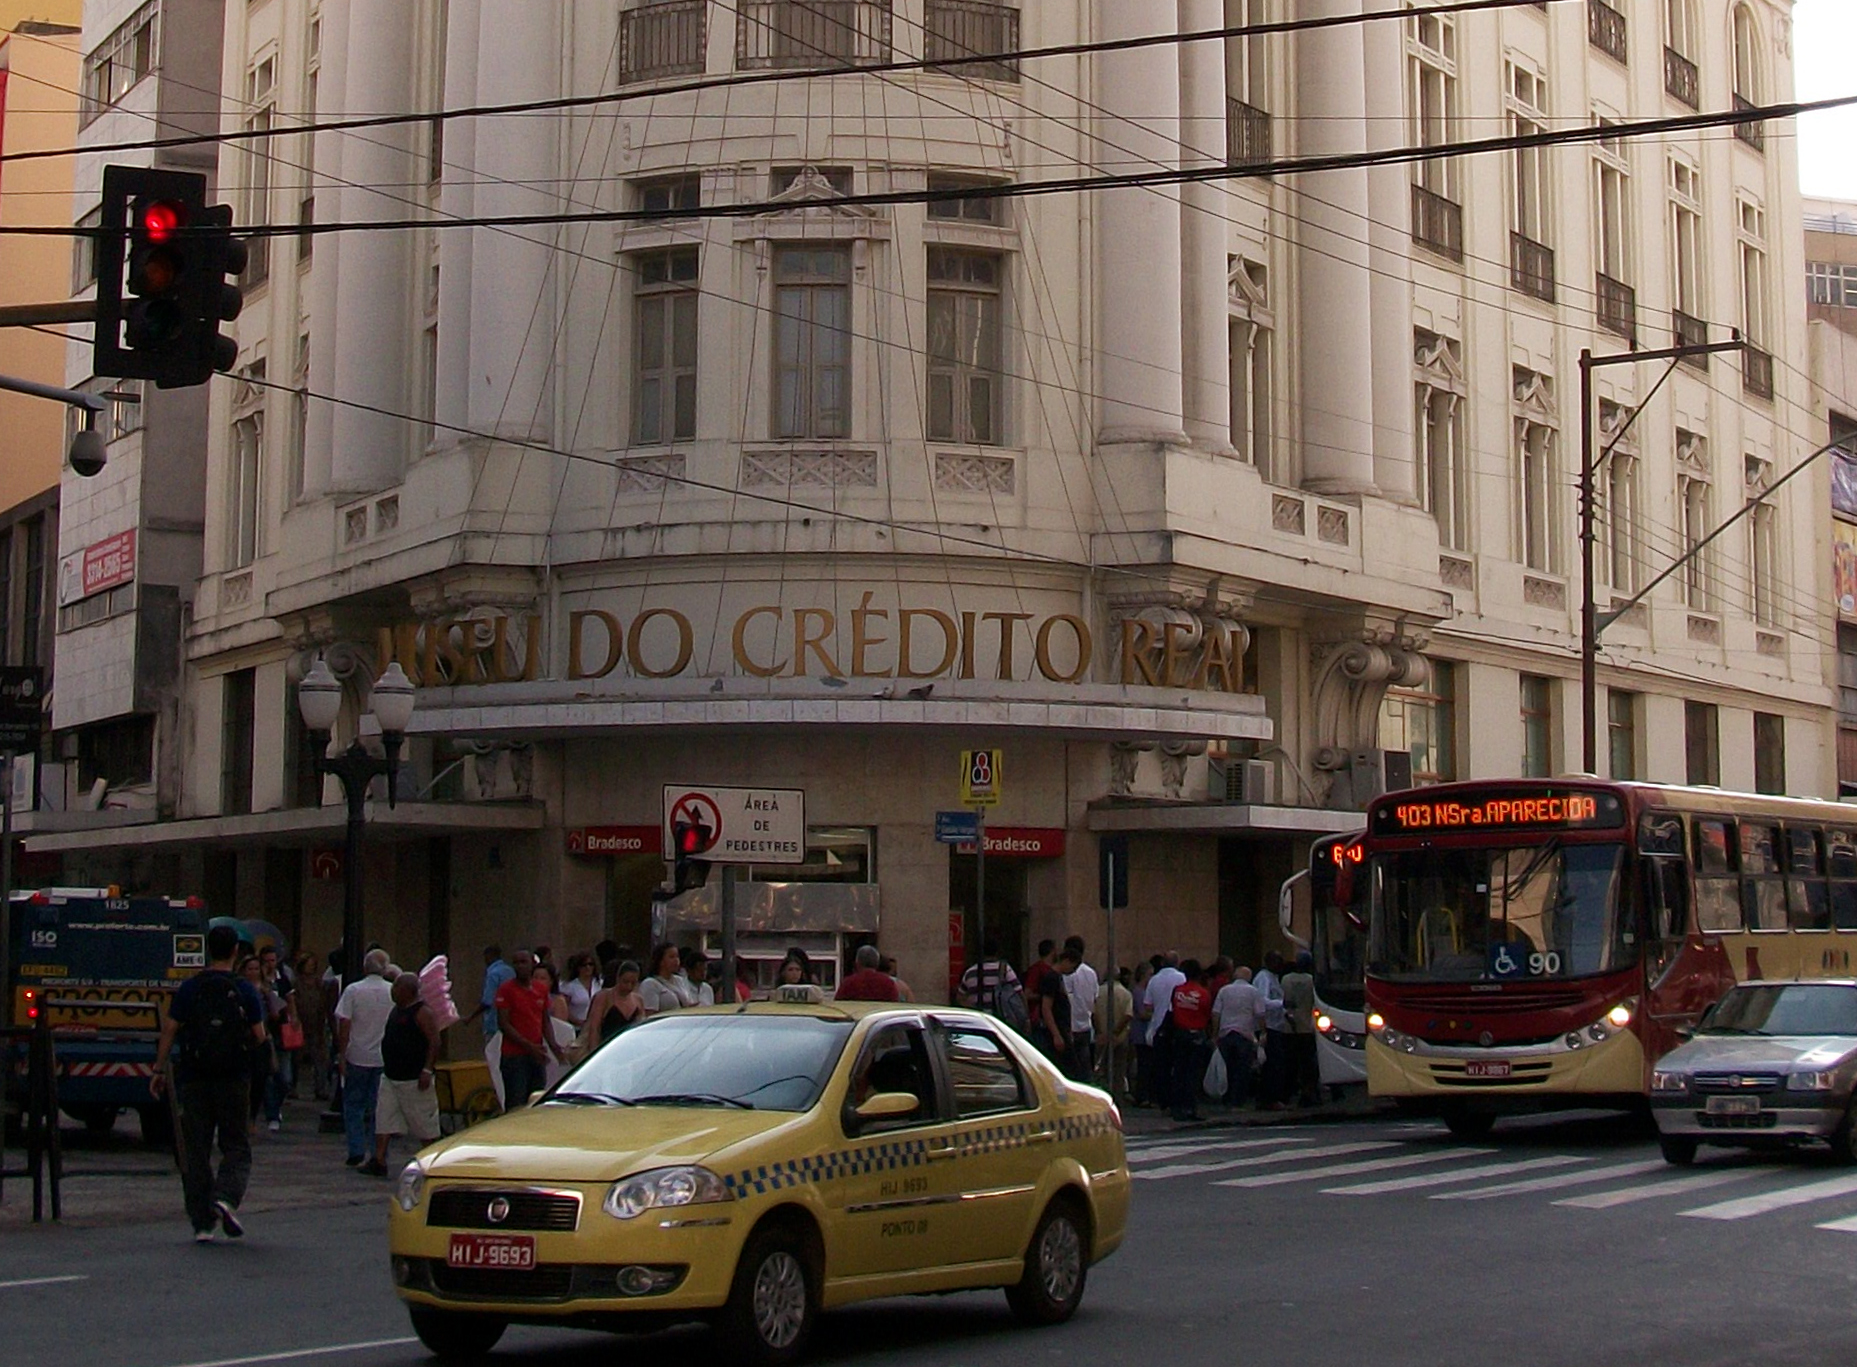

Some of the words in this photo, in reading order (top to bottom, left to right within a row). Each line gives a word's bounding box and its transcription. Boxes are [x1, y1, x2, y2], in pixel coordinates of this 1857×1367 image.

[568, 608, 694, 680] DO
[732, 590, 1093, 683] CRÉDITO
[1397, 805, 1431, 827] 403
[754, 820, 770, 832] DE
[587, 835, 642, 850] Bradesco
[726, 840, 798, 853] PEDESTRES
[983, 836, 1041, 851] Bradesco
[104, 900, 130, 910] 1825
[31, 930, 58, 943] ISO
[1528, 952, 1561, 975] 90
[781, 987, 808, 1002] TAXI
